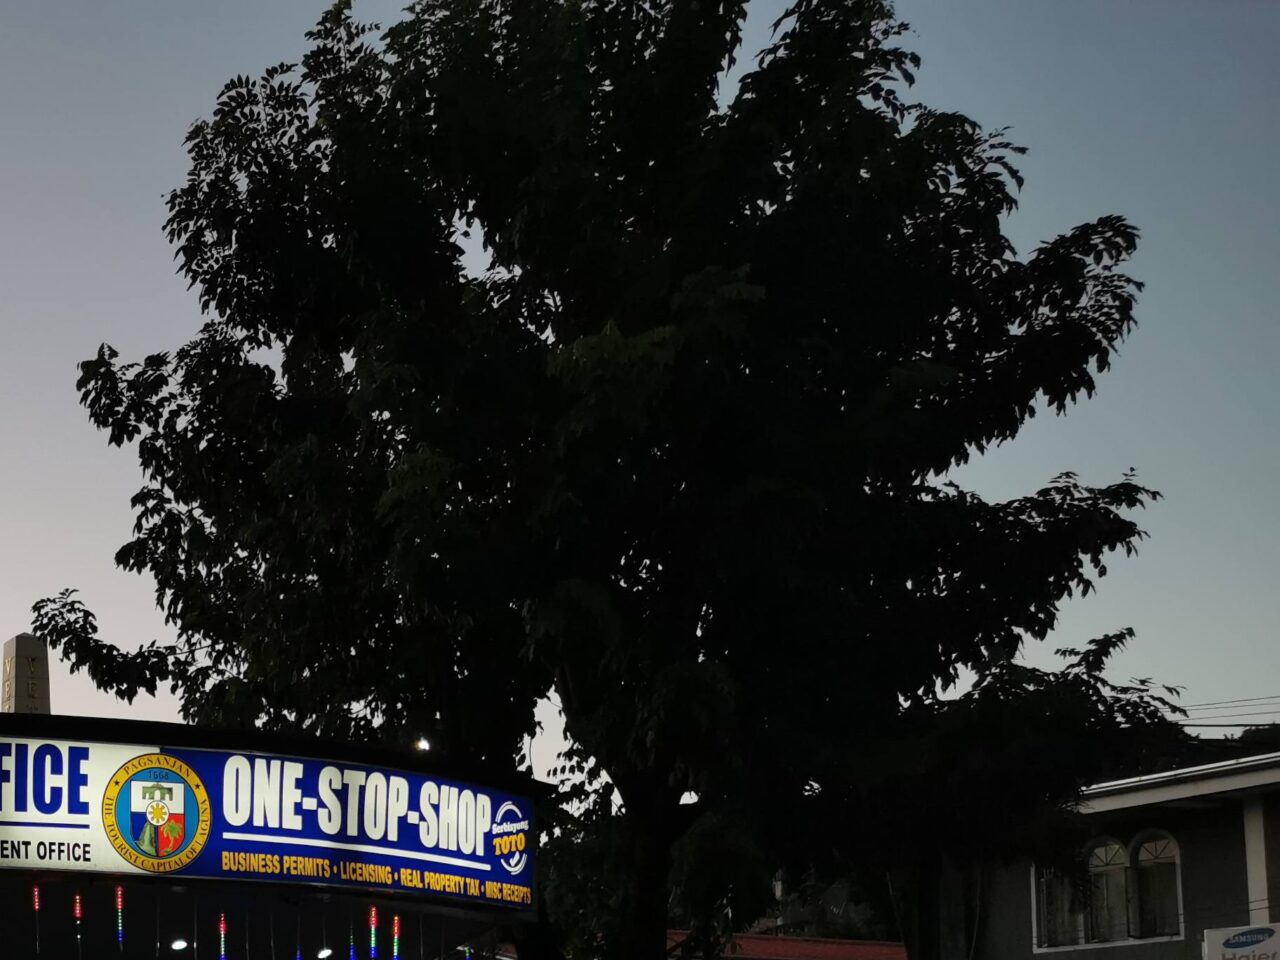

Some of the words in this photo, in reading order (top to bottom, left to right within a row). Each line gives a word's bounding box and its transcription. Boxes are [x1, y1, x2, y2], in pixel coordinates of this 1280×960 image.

[123, 756, 191, 778] PAGSANJAN
[104, 797, 114, 816] THE
[222, 754, 491, 856] ONE-STOP-SHOP
[196, 798, 209, 847] LAGUNA
[36, 841, 92, 862] OFFICE
[107, 823, 138, 862] TOURIST
[185, 846, 197, 858] OF
[493, 832, 526, 856] TOTO
[141, 857, 185, 871] CAPITAL
[222, 851, 280, 875] BUSINESS
[283, 855, 331, 879] PERMITS
[340, 861, 393, 885] LICENSING
[400, 867, 424, 888] REAL
[424, 871, 465, 895] PROPERTY
[466, 878, 480, 896] TAX
[485, 881, 502, 899] MISC
[502, 883, 532, 905] RECEIPTS
